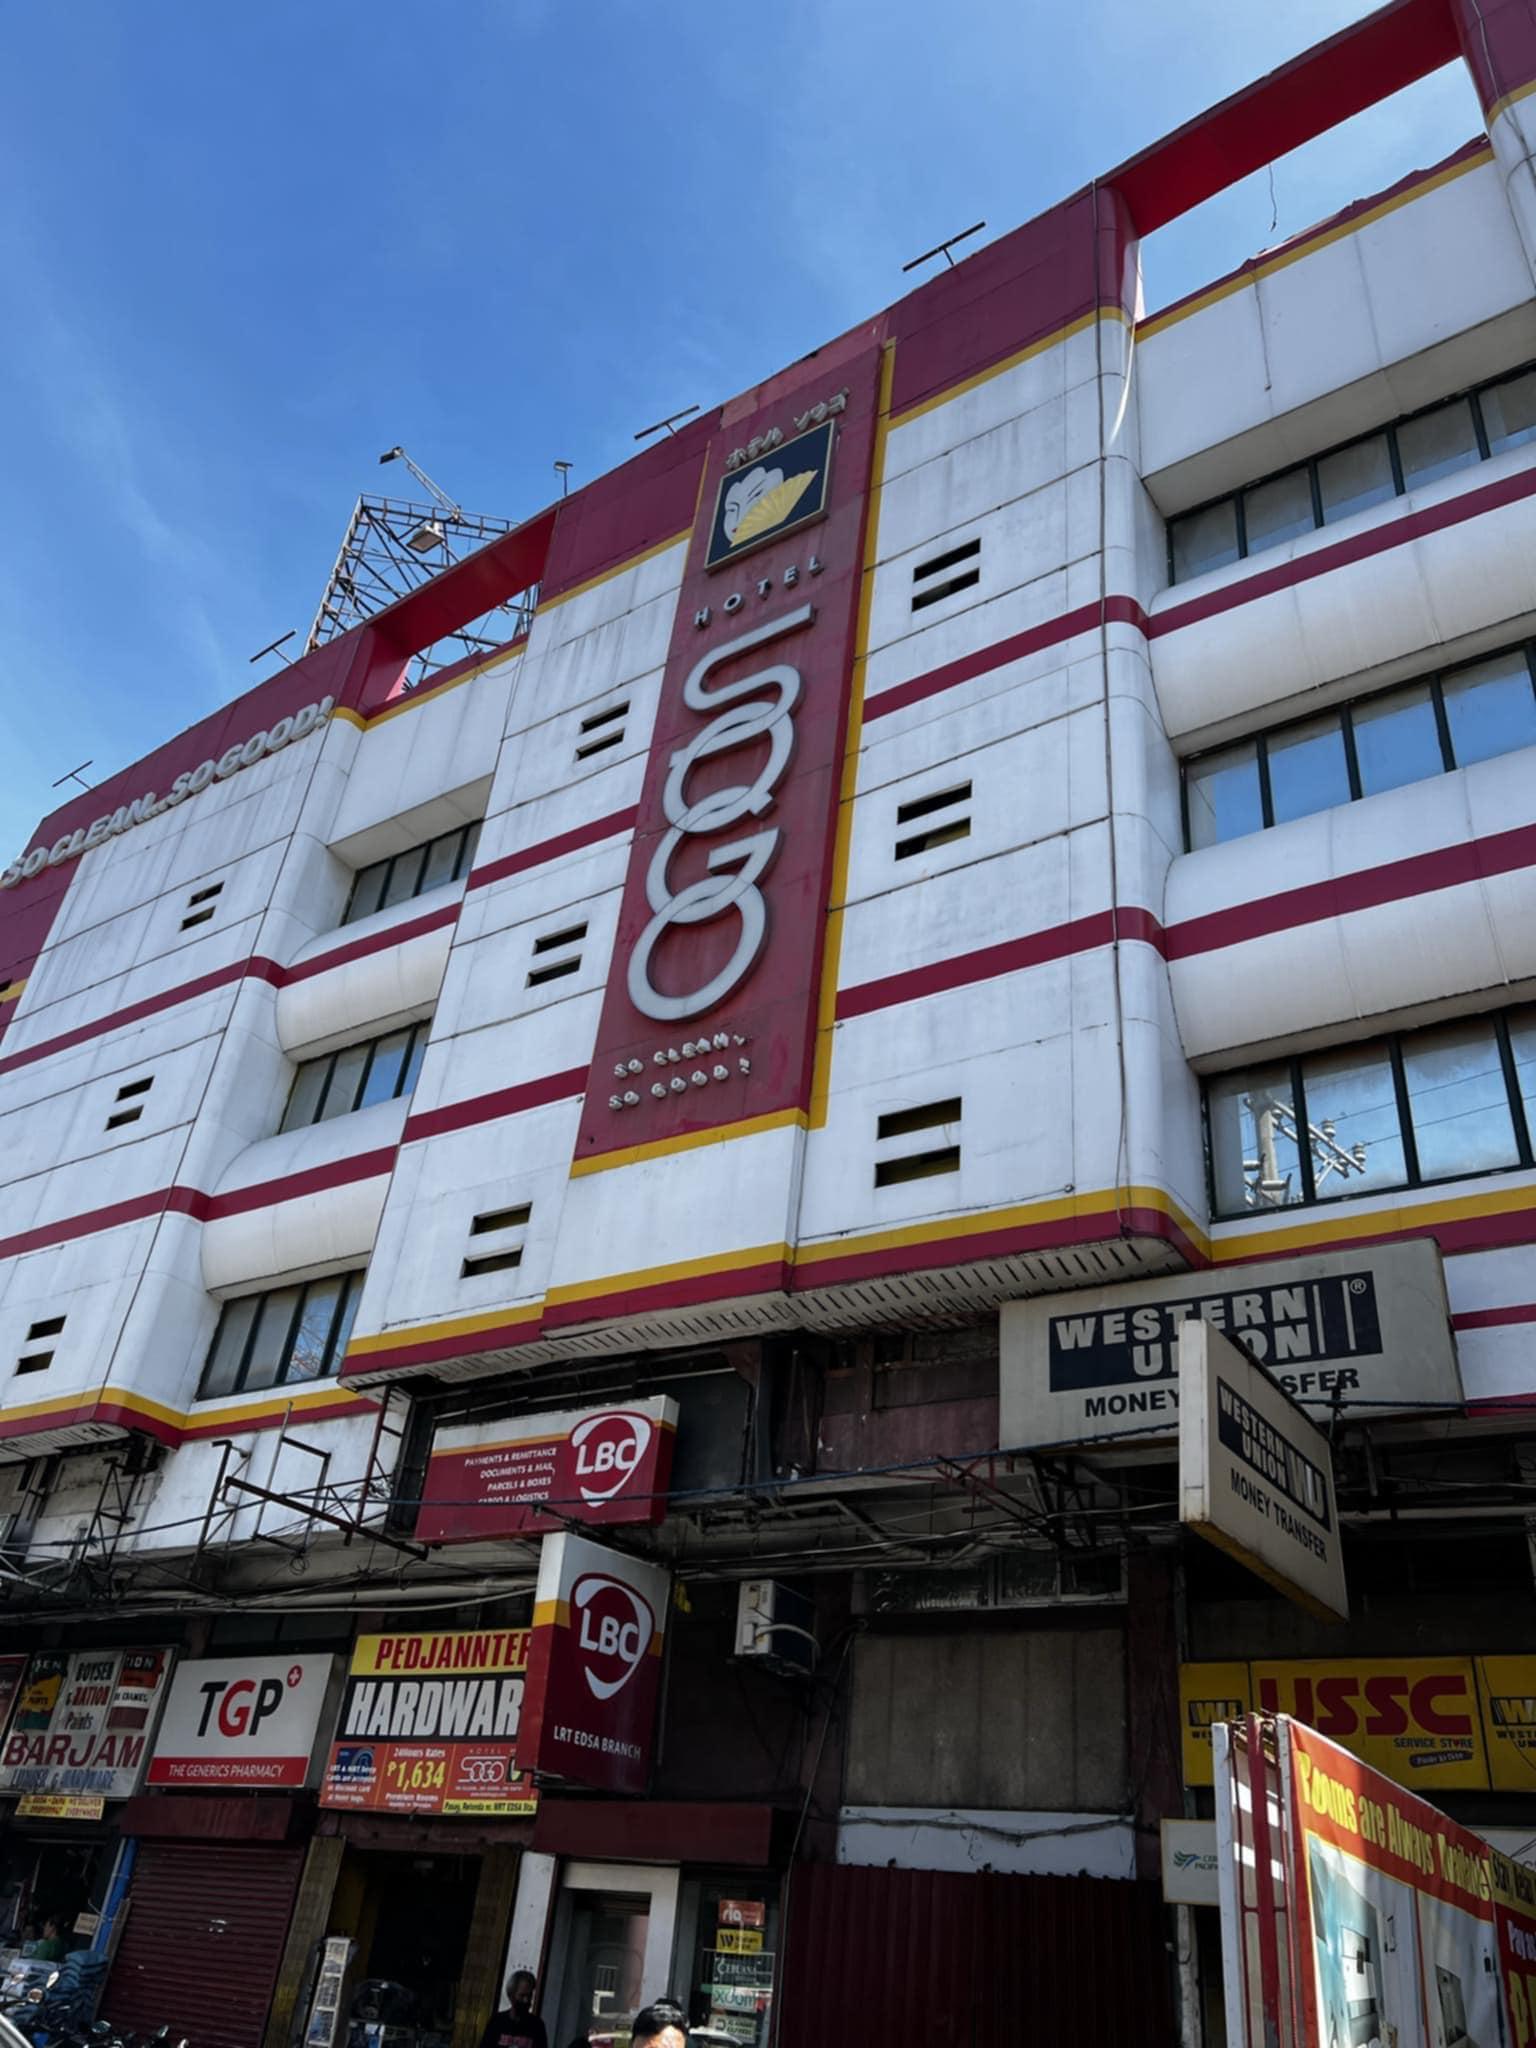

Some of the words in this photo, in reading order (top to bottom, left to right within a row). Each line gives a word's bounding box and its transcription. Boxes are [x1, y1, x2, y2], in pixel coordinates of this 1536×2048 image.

[694, 555, 825, 630] HOTEL
[0, 846, 49, 889] SO
[215, 695, 335, 779] GOOD!
[627, 602, 816, 1022] SOGO
[614, 1058, 644, 1079] SO
[608, 1090, 640, 1111] SO
[1056, 1286, 1308, 1350] WESTERN
[1132, 1324, 1312, 1377] UON
[1085, 1389, 1179, 1417] MONEY
[1220, 1384, 1287, 1466] WESTERN
[464, 1454, 503, 1466] PAYMENTS
[511, 1447, 557, 1461] REMITTANCE
[480, 1465, 526, 1479] DOCUMENTS
[575, 1437, 638, 1476] LBC
[1242, 1431, 1288, 1490] UNION
[487, 1481, 518, 1491] PARCELS
[527, 1477, 552, 1486] BOXES
[1231, 1467, 1272, 1518] MONEY
[1273, 1503, 1327, 1563] TRANSFER
[580, 1608, 640, 1663] LBC
[65, 1711, 94, 1730] Paints
[197, 1679, 284, 1738] TGP
[344, 1679, 525, 1736] HARDWAR
[1260, 1675, 1472, 1735] USSC
[2, 1734, 146, 1768] BARJAM
[553, 1725, 573, 1742] LRT
[574, 1730, 600, 1749] EDSA
[600, 1735, 642, 1760] BRANCH
[1393, 1738, 1435, 1748] SERVICE
[168, 1764, 187, 1777] THE
[187, 1764, 230, 1777] GENERICS
[230, 1764, 285, 1777] PHARMACY
[1297, 1750, 1358, 1835] Rooms
[1358, 1796, 1386, 1849] are
[1387, 1803, 1434, 1876] Always
